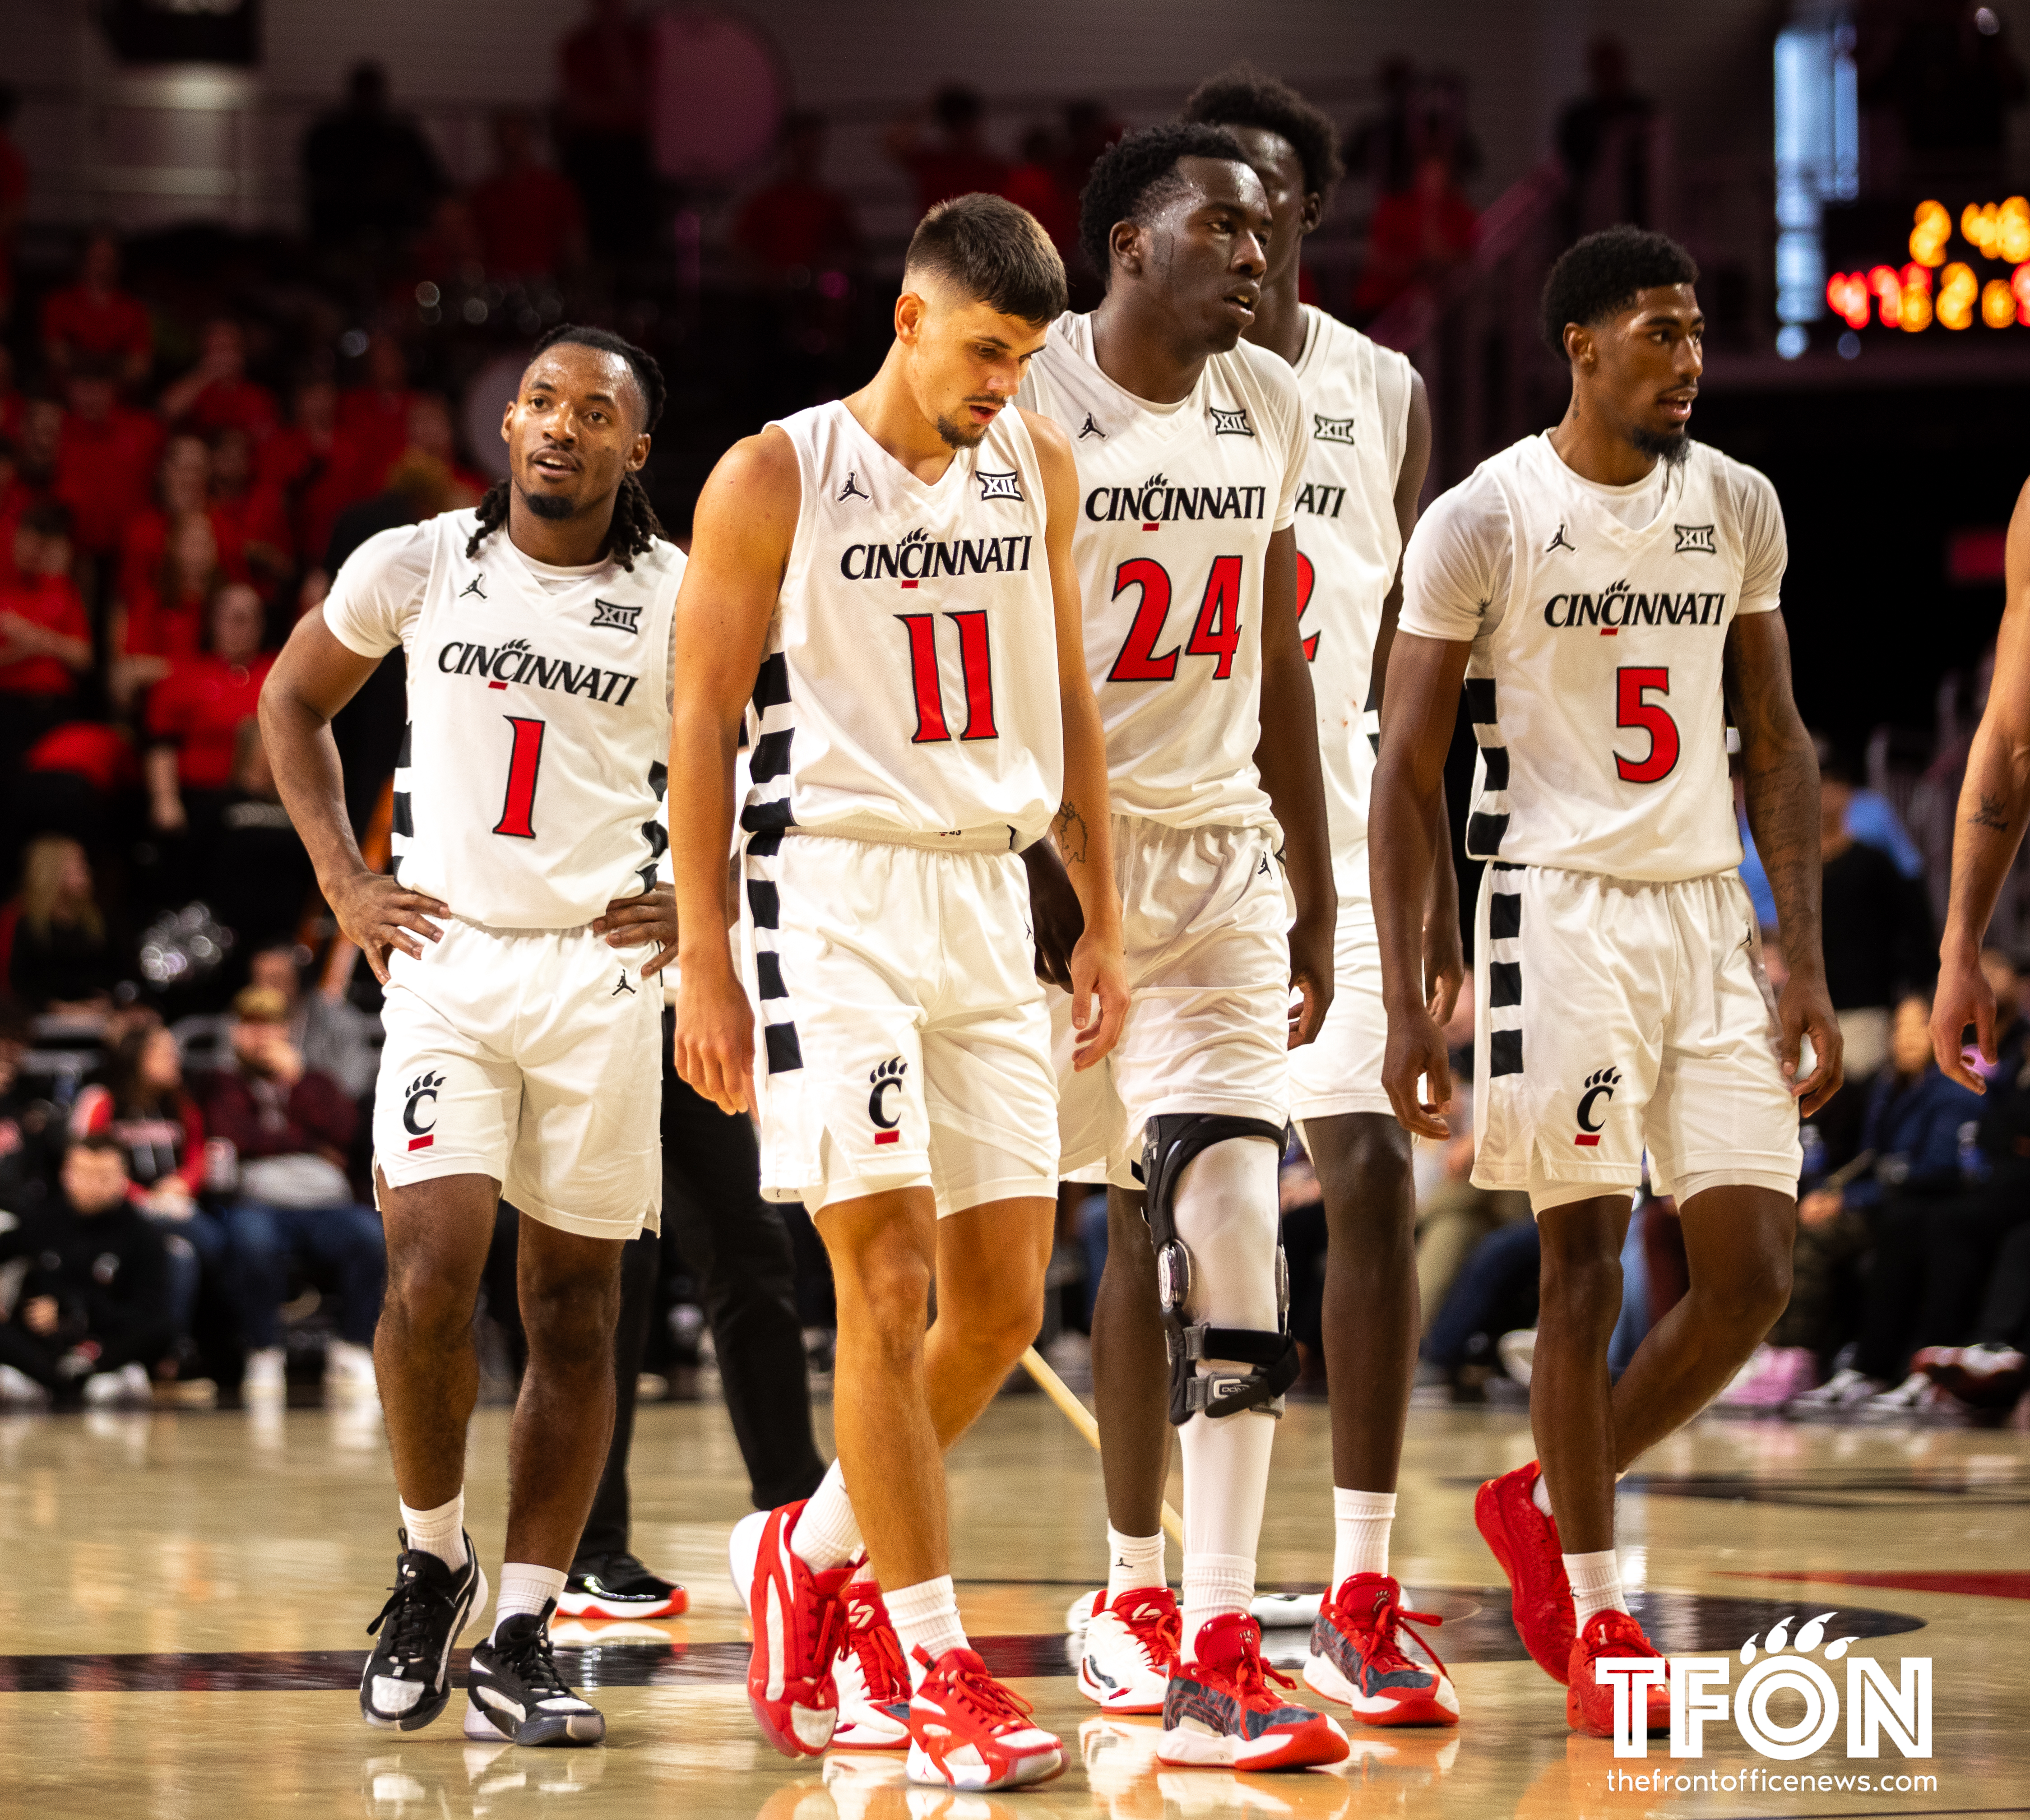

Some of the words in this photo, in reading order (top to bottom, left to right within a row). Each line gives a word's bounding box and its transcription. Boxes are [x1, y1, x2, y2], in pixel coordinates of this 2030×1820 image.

[1085, 485, 1266, 522] CINCINNATI
[841, 535, 1032, 580] CINCINNATI
[1106, 556, 1243, 682] 24
[1544, 593, 1726, 627] CINCINNATI
[438, 641, 639, 706] CINCINNATI
[893, 609, 999, 744] 11
[1613, 667, 1680, 783] 5
[492, 715, 546, 839] 1
